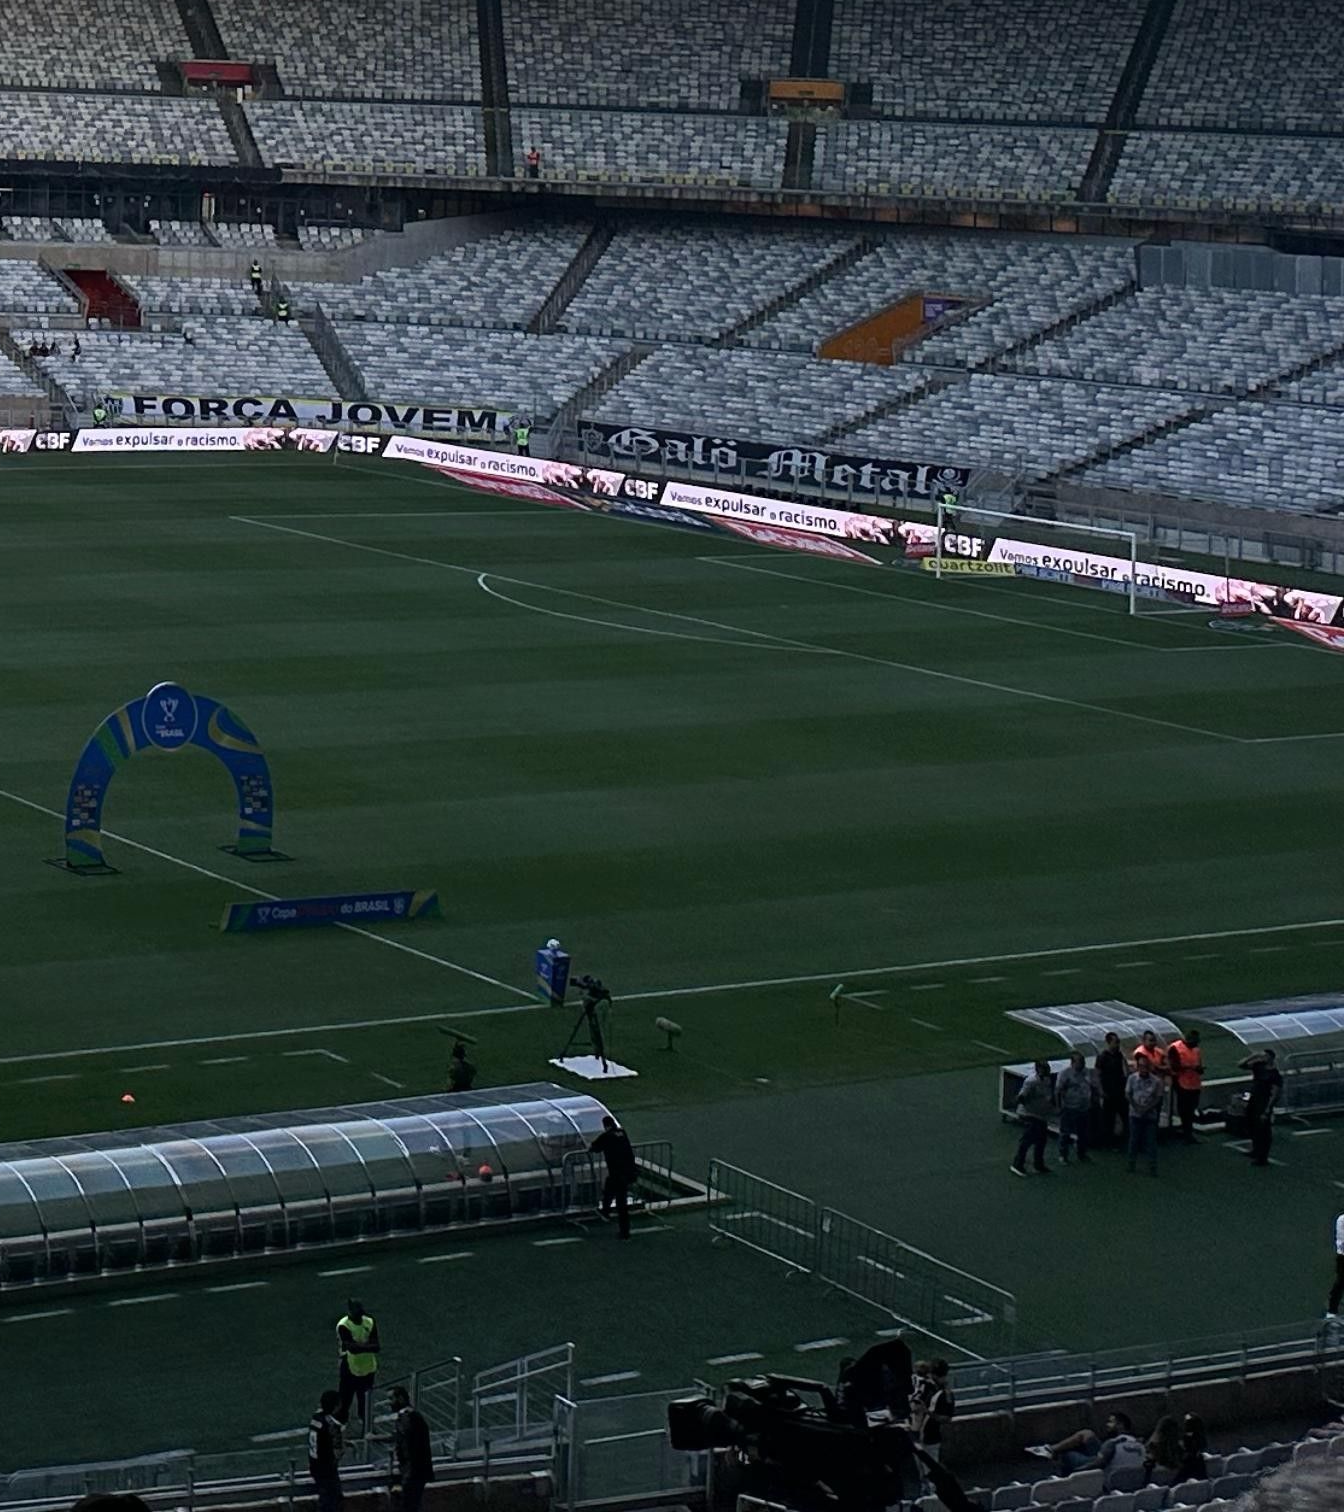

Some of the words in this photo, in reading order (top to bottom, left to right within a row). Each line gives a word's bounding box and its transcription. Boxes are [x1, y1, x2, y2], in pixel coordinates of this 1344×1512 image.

[316, 402, 497, 432] JOVEM
[36, 433, 70, 450] CBF
[116, 434, 174, 447] expulsar
[185, 434, 239, 446] racismo.
[426, 445, 477, 466] expulsar
[488, 459, 539, 477] racismo.
[756, 448, 937, 494] Metal
[624, 479, 658, 499] CBF
[705, 495, 767, 517] expulsar
[779, 509, 840, 532] racismo.
[944, 533, 982, 557] CBF
[354, 900, 391, 914] BRASIL
